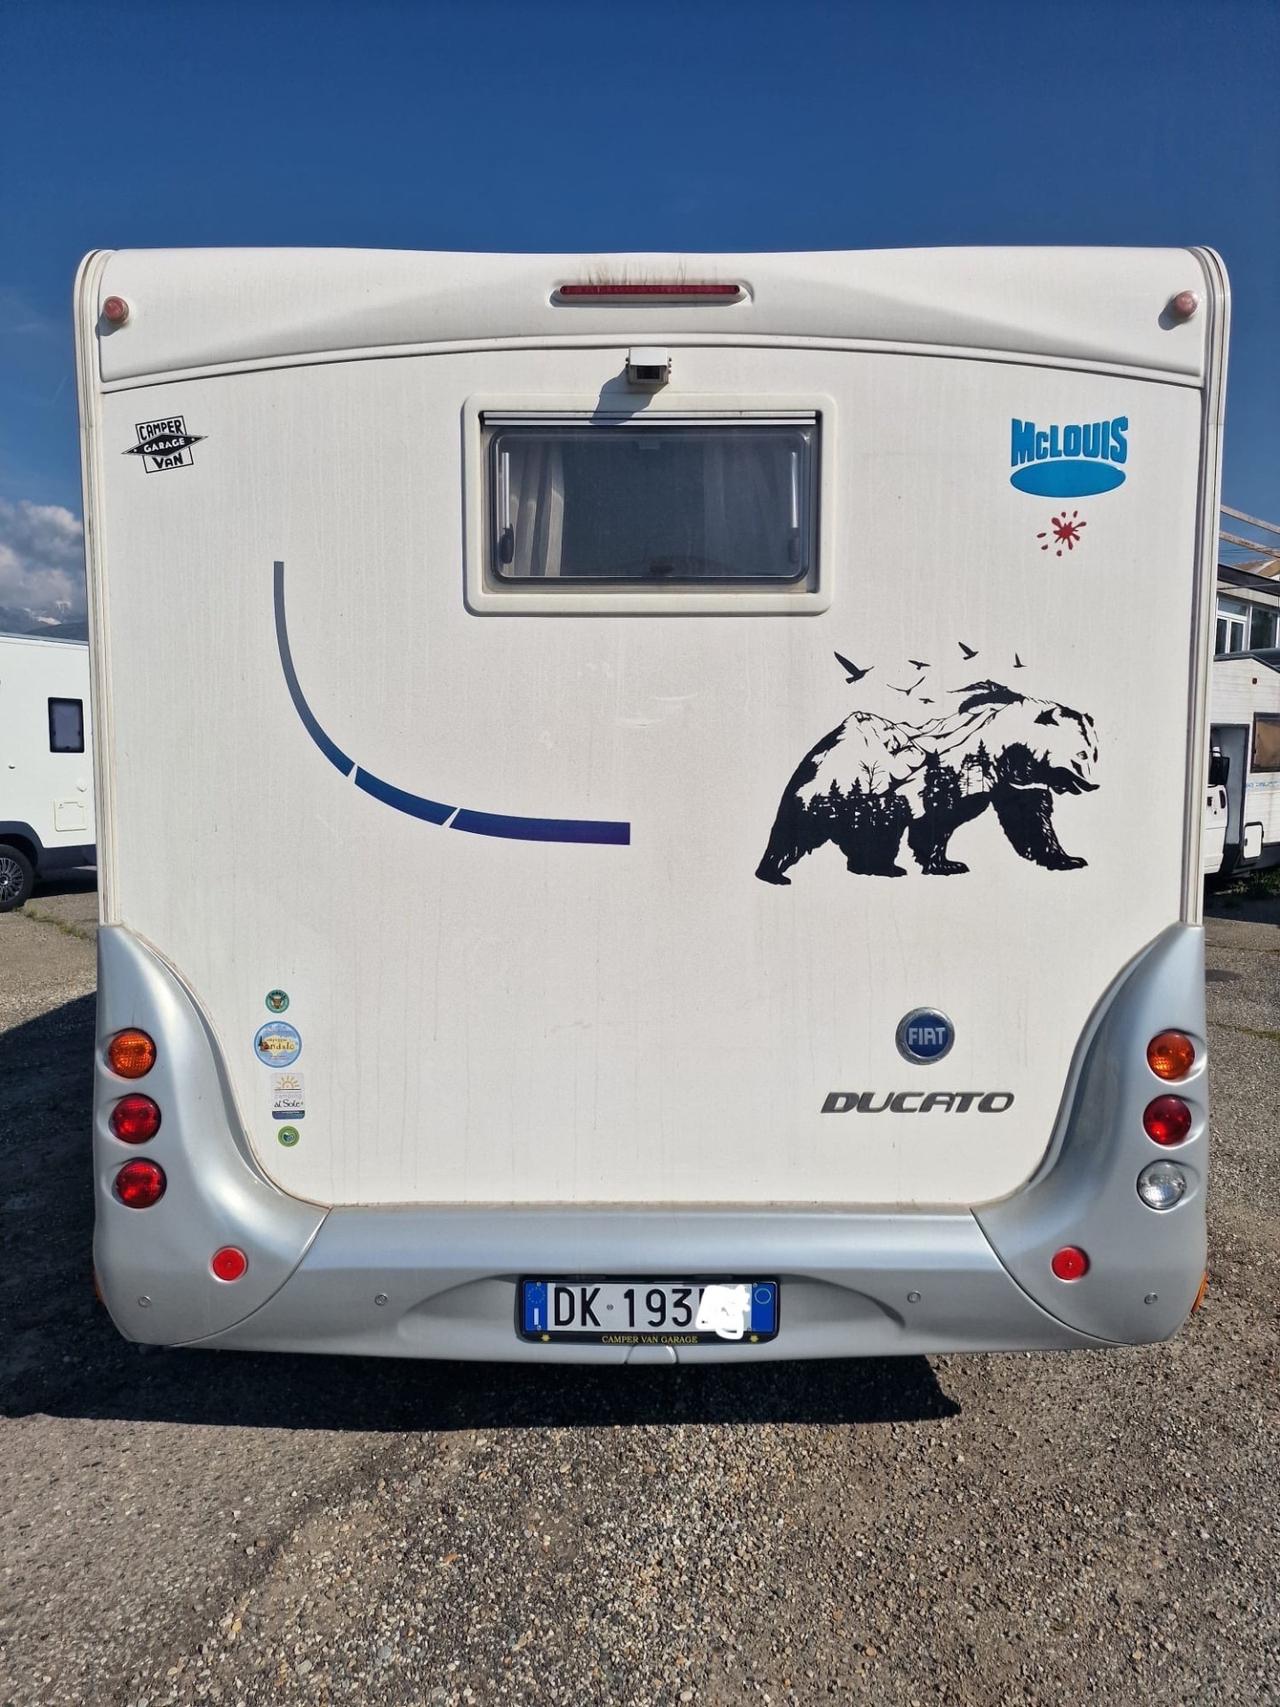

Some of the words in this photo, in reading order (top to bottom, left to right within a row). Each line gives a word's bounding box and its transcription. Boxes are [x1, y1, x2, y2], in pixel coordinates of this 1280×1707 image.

[139, 420, 184, 440] CAMPER
[143, 438, 185, 452] GARAGE
[1011, 416, 1128, 467] McLOUIS
[152, 452, 184, 469] VAN
[908, 1027, 946, 1045] FIAT
[820, 1091, 1015, 1113] DUCATO
[554, 1287, 601, 1327] DK
[623, 1287, 706, 1328] 193
[601, 1335, 639, 1344] CAMPER
[641, 1335, 659, 1344] VAN
[660, 1335, 698, 1344] GARAGE
